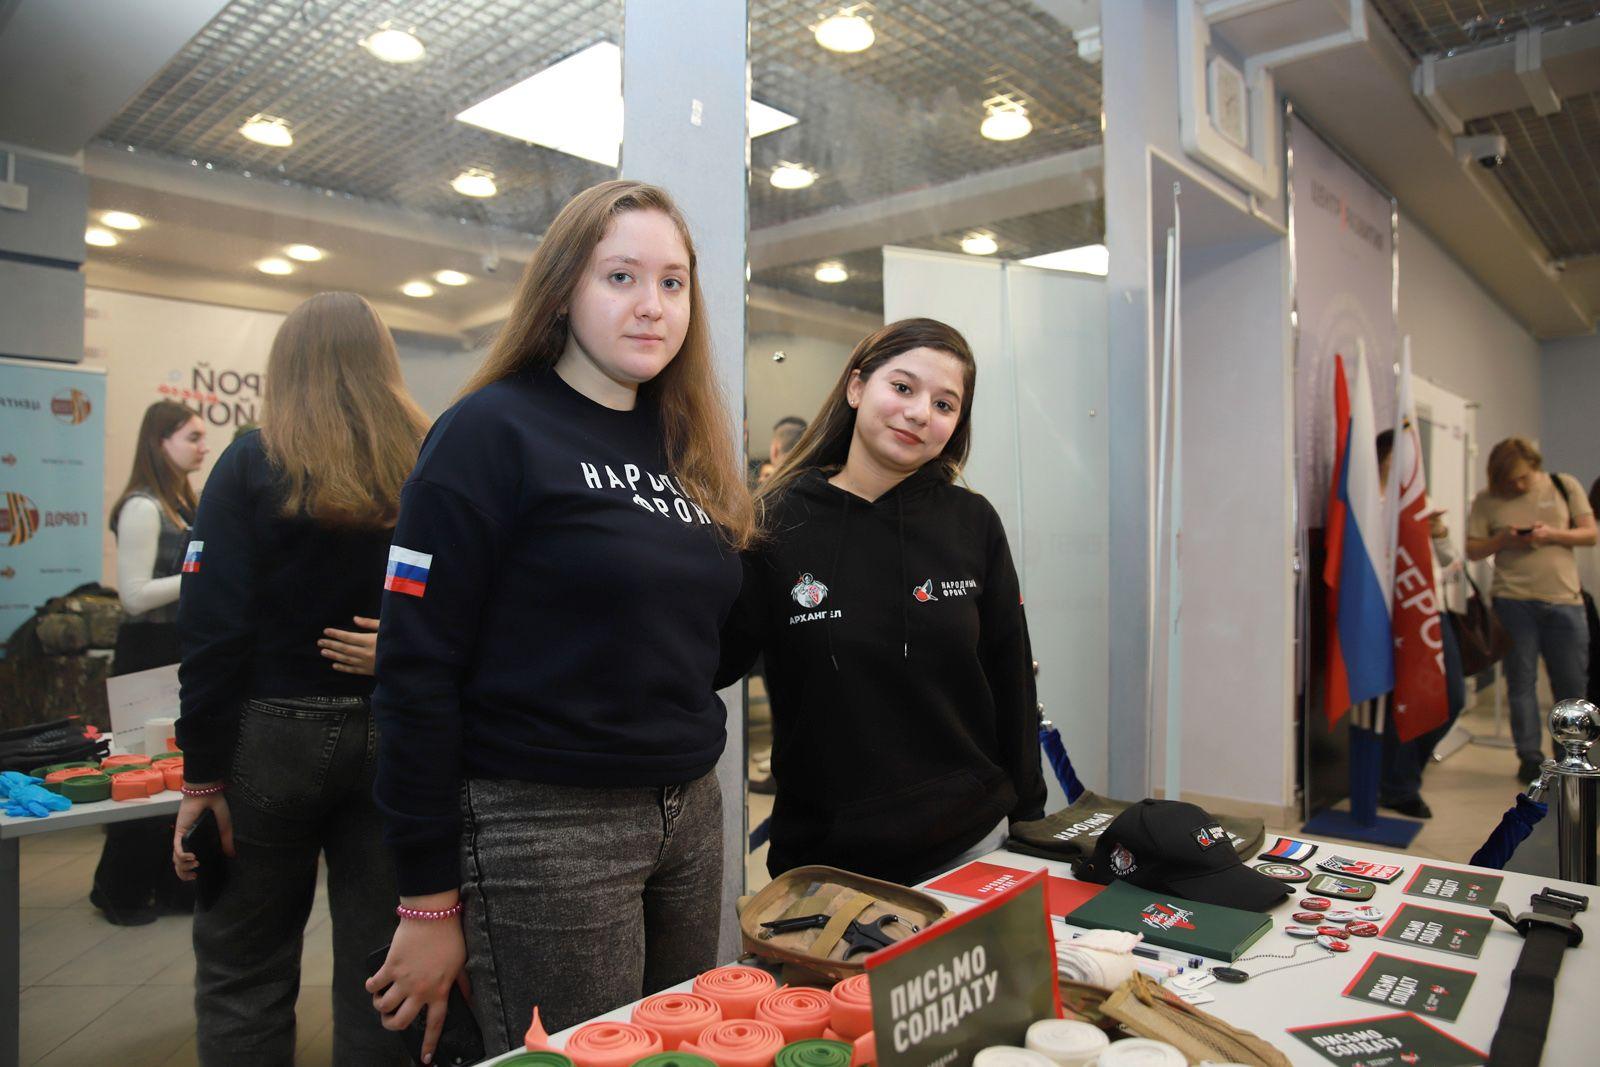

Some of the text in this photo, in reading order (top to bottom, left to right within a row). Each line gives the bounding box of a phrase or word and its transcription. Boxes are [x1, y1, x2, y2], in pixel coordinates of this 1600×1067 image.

[632, 493, 724, 525] ФРОН
[942, 588, 967, 597] ФРОНТ
[890, 945, 987, 1020] ПИСЬМО
[1368, 974, 1399, 1001] ПИСЬМО
[1388, 975, 1419, 1006] СОЛДАТУ
[893, 970, 999, 1053] СОЛДАТУ
[1312, 1028, 1384, 1049] ПИСЬМО
[1326, 1036, 1403, 1058] СОЛДАТУ
